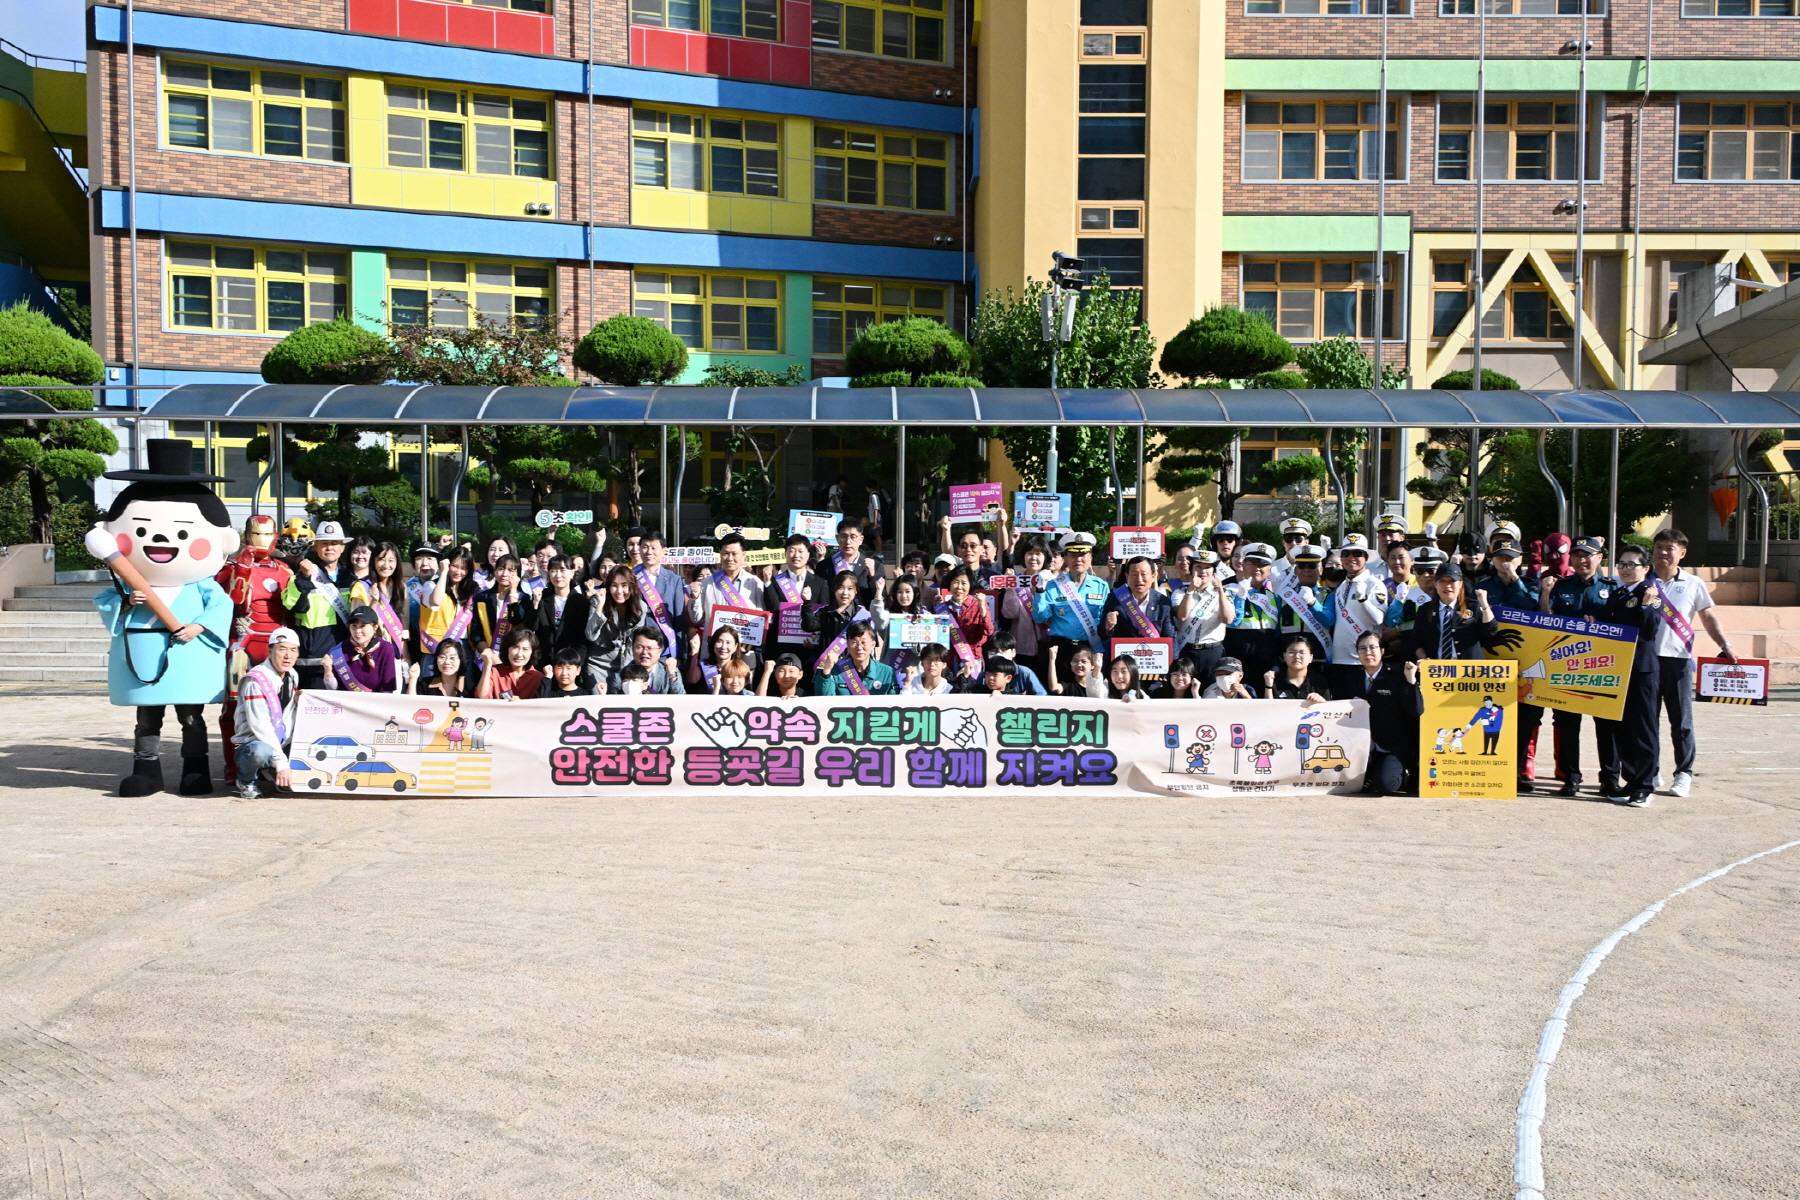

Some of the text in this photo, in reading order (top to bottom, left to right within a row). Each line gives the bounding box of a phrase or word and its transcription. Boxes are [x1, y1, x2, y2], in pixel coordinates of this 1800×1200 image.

[552, 512, 564, 524] 초
[565, 511, 593, 523] 확인!
[743, 528, 769, 539] 배려!
[664, 548, 714, 557] 도를 줄이면,
[660, 556, 715, 564] 사고도 줄어듭니다
[990, 575, 1017, 589] 멈춤!
[1018, 576, 1031, 589] 초
[1501, 609, 1624, 637] 모르는 사람이 손을 잡으면!
[1549, 640, 1593, 662] 싫어요!
[1566, 654, 1616, 672] 안 돼요!
[1427, 665, 1511, 679] 함께 지켜요!
[1432, 681, 1507, 693] 우리 아이 안전
[1549, 673, 1621, 688] 도와주세요!
[304, 706, 330, 715] 안전한
[1322, 711, 1353, 720] 안산시
[560, 706, 1109, 749] 스쿨존 약속 지킬게 챌린지
[550, 746, 1119, 788] 안전한 등굣길 우리 함께 지켜요
[1167, 784, 1194, 792] 무단횡단
